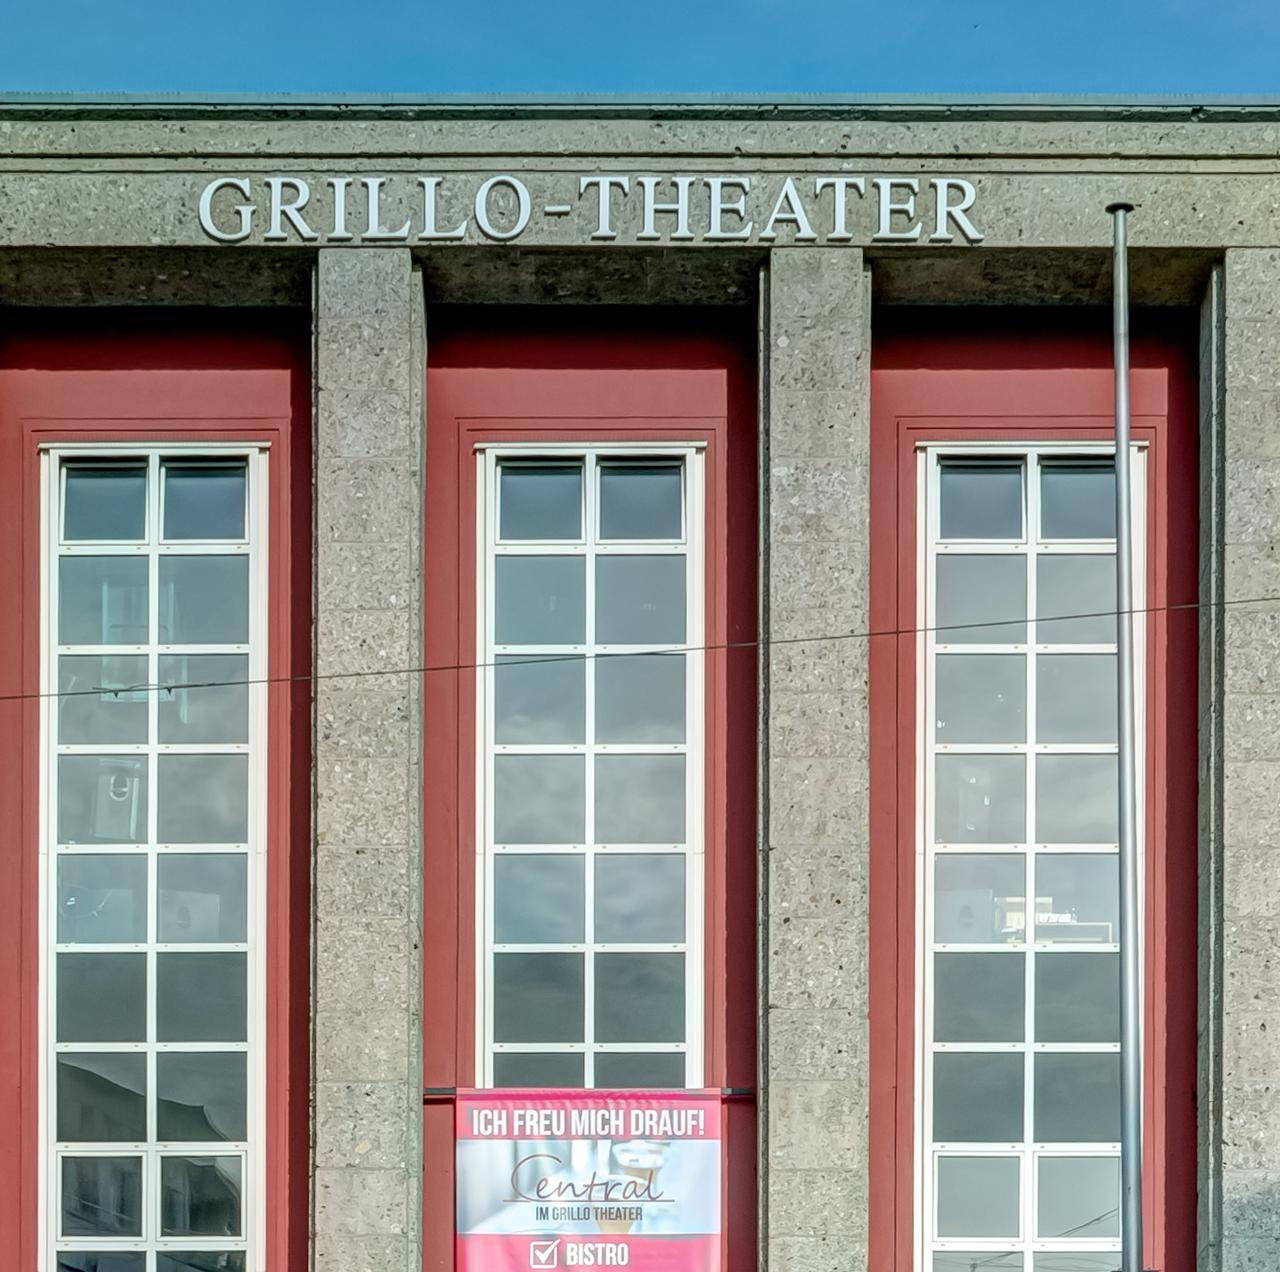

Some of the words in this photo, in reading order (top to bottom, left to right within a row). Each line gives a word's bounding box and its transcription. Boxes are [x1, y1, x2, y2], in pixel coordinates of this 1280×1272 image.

[198, 175, 984, 242] GRILLO-THEATER
[473, 1109, 507, 1136] ICH
[513, 1109, 566, 1136] FREU
[572, 1109, 624, 1136] MICH
[631, 1109, 705, 1136] DRAUF!
[511, 1153, 664, 1202] Central
[536, 1206, 549, 1221] IM
[552, 1206, 591, 1221] GRILLO
[593, 1206, 643, 1221] THEATER
[566, 1243, 629, 1266] BISTRO
